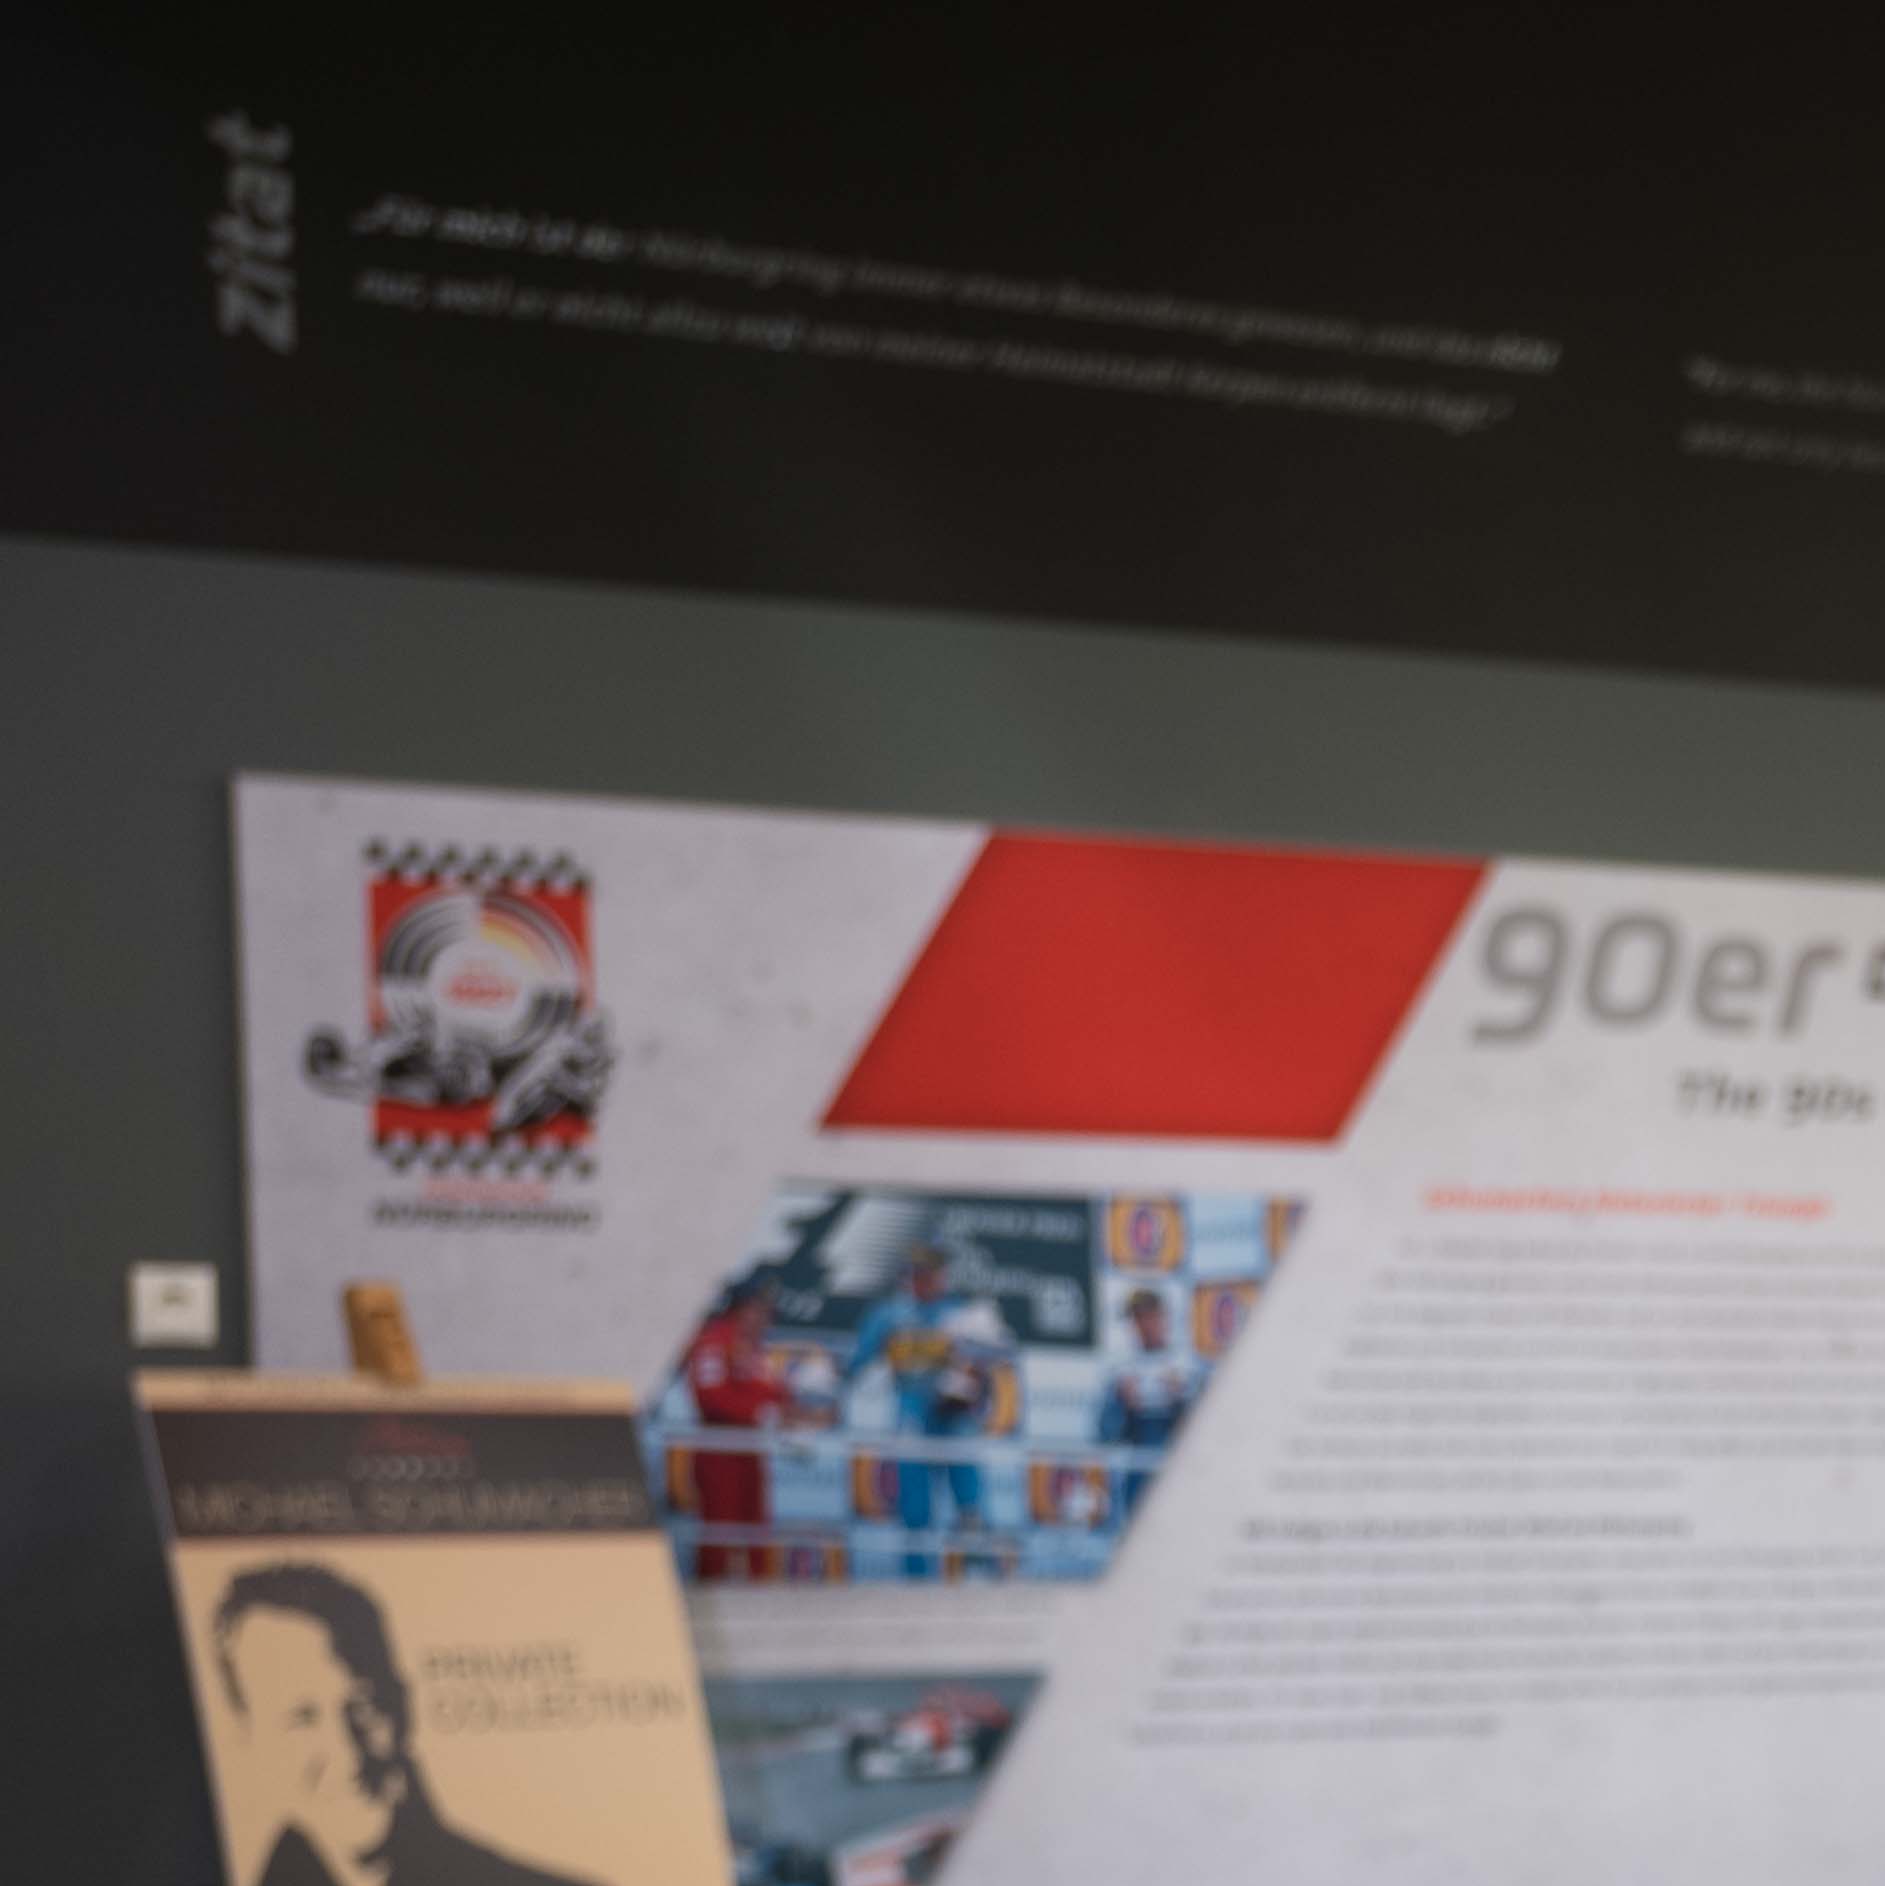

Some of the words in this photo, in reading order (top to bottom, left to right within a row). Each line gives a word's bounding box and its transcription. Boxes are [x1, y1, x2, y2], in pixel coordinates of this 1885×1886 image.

[208, 110, 297, 354] zitat
[1470, 901, 1847, 1050] 90er
[1677, 1071, 1759, 1116] The
[1782, 1075, 1875, 1127] 90s
